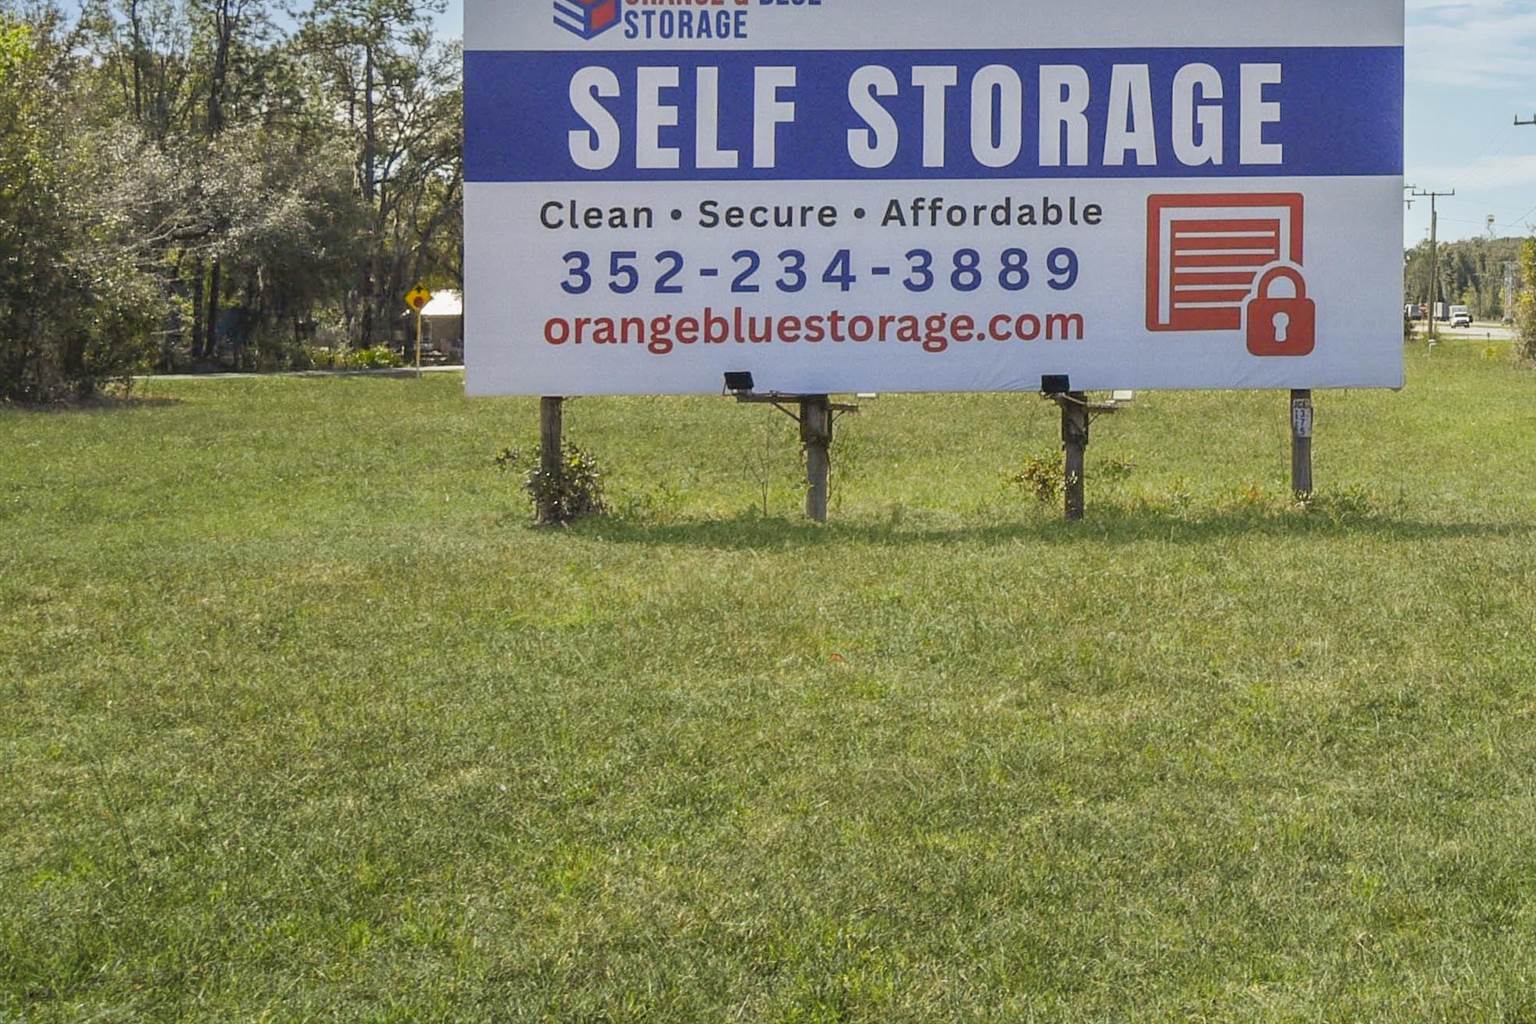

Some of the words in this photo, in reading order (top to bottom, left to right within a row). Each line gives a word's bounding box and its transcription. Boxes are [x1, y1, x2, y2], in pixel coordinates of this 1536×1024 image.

[624, 9, 748, 40] STORAGE
[569, 66, 797, 170] SELF
[847, 63, 1283, 169] STORAGE
[540, 199, 653, 230] Clean
[699, 199, 838, 229] Secure
[881, 197, 1103, 228] Affordable
[561, 247, 1079, 294] 352-234-3889
[543, 307, 1084, 355] orangebluestorage.com
